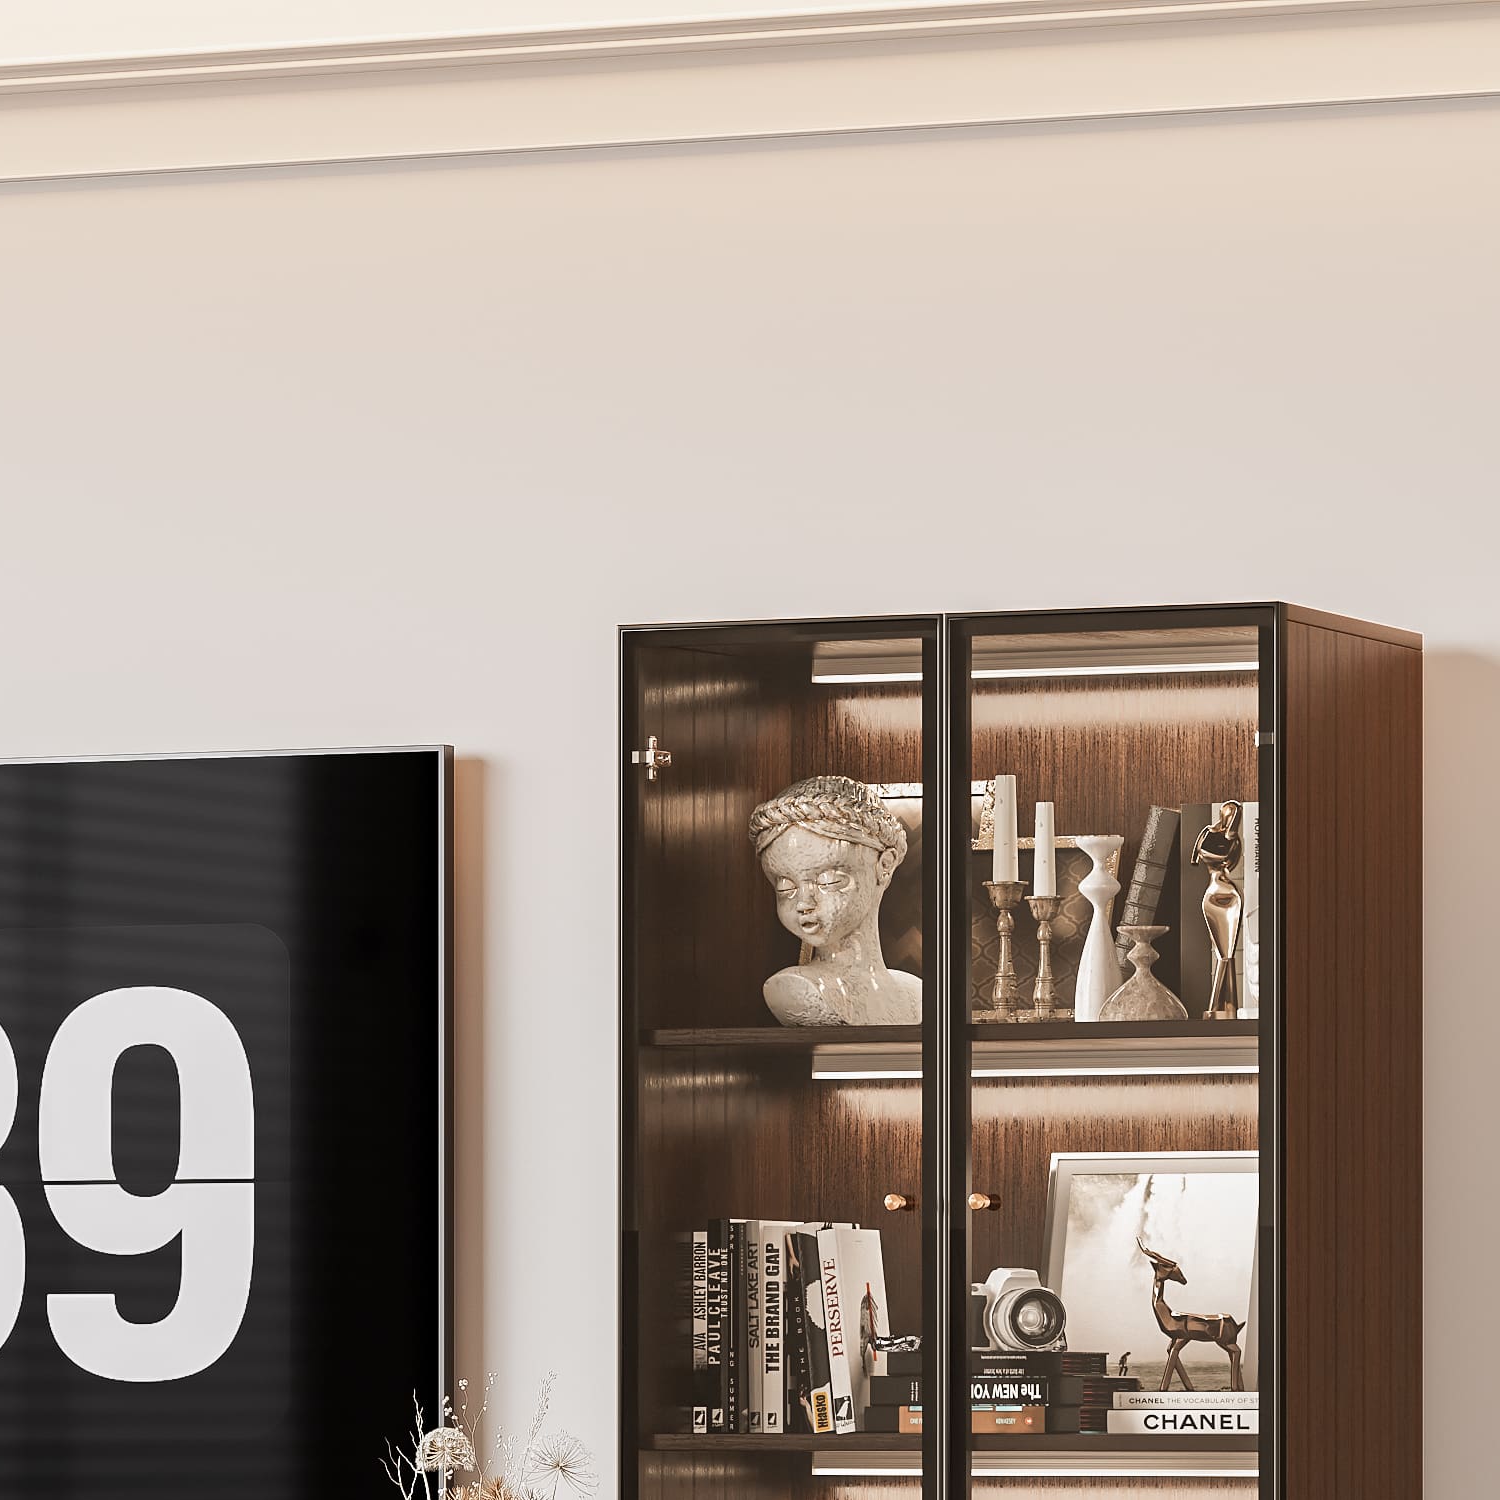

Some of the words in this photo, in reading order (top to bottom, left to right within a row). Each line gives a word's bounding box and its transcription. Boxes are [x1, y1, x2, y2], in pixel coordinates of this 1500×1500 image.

[693, 1241, 707, 1282] BARRON
[720, 1247, 729, 1267] ONE
[747, 1241, 758, 1270] ART
[765, 1243, 780, 1277] GAP
[708, 1248, 721, 1315] CLEAVE
[720, 1271, 729, 1283] NO
[747, 1272, 759, 1310] LAKE
[693, 1285, 707, 1321] ASHLEY
[720, 1288, 729, 1318] TRUST
[765, 1281, 780, 1339] BRAND
[794, 1296, 803, 1334] BOOK
[823, 1258, 844, 1357] PERSERVE
[693, 1332, 707, 1351] AVA
[708, 1321, 721, 1365] PAUL
[748, 1312, 760, 1349] SALT
[765, 1343, 780, 1374] THE
[992, 1383, 1019, 1399] NEW
[1020, 1383, 1042, 1401] The
[1143, 1414, 1251, 1430] CHANEL
